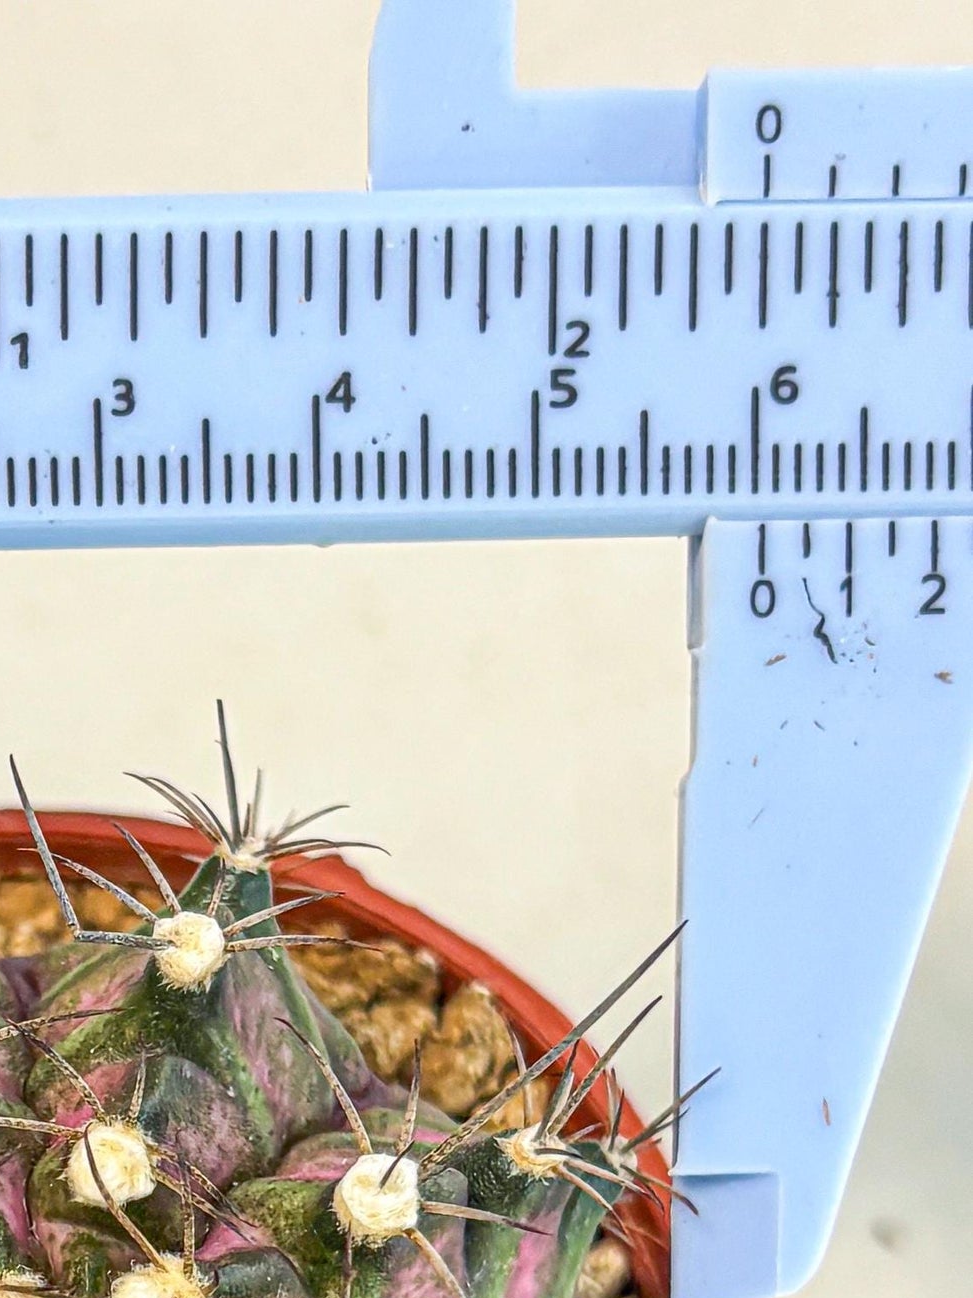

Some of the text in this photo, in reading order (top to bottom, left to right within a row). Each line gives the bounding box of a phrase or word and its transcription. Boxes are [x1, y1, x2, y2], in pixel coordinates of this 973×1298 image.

[755, 104, 783, 144] 0
[10, 332, 29, 370] 1
[563, 320, 591, 359] 2
[110, 378, 136, 417] 3
[325, 371, 357, 413] 4
[549, 368, 578, 409] 5
[769, 365, 800, 405] 6
[749, 573, 947, 619] 0 1 2
